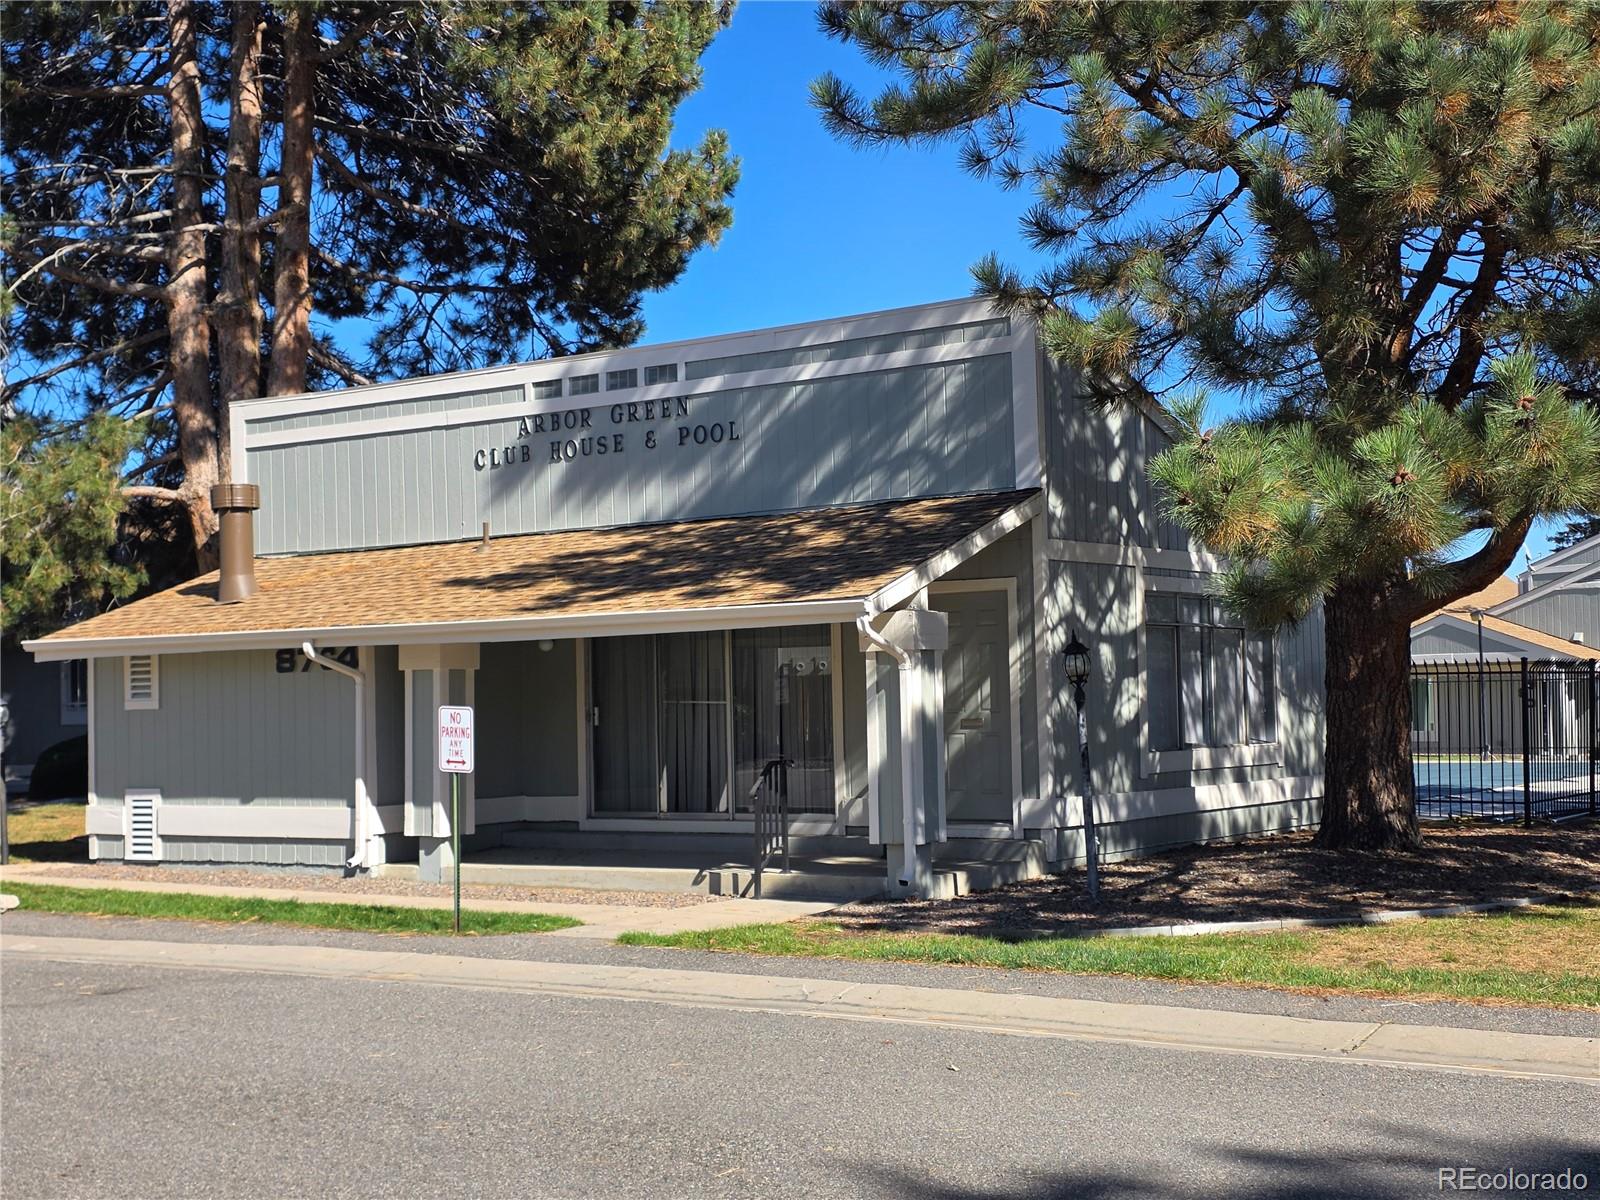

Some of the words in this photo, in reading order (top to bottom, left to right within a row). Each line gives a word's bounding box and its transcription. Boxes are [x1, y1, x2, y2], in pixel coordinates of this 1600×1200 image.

[519, 408, 592, 437] ARBOR
[610, 397, 689, 424] GREEN
[474, 444, 531, 470] CLUB
[549, 434, 624, 461] HOUSE
[645, 430, 657, 449] &
[677, 421, 740, 446] POOL
[450, 711, 462, 725] NO
[441, 726, 470, 739] PARKING
[449, 739, 462, 748] ANY
[448, 748, 464, 758] TIME
